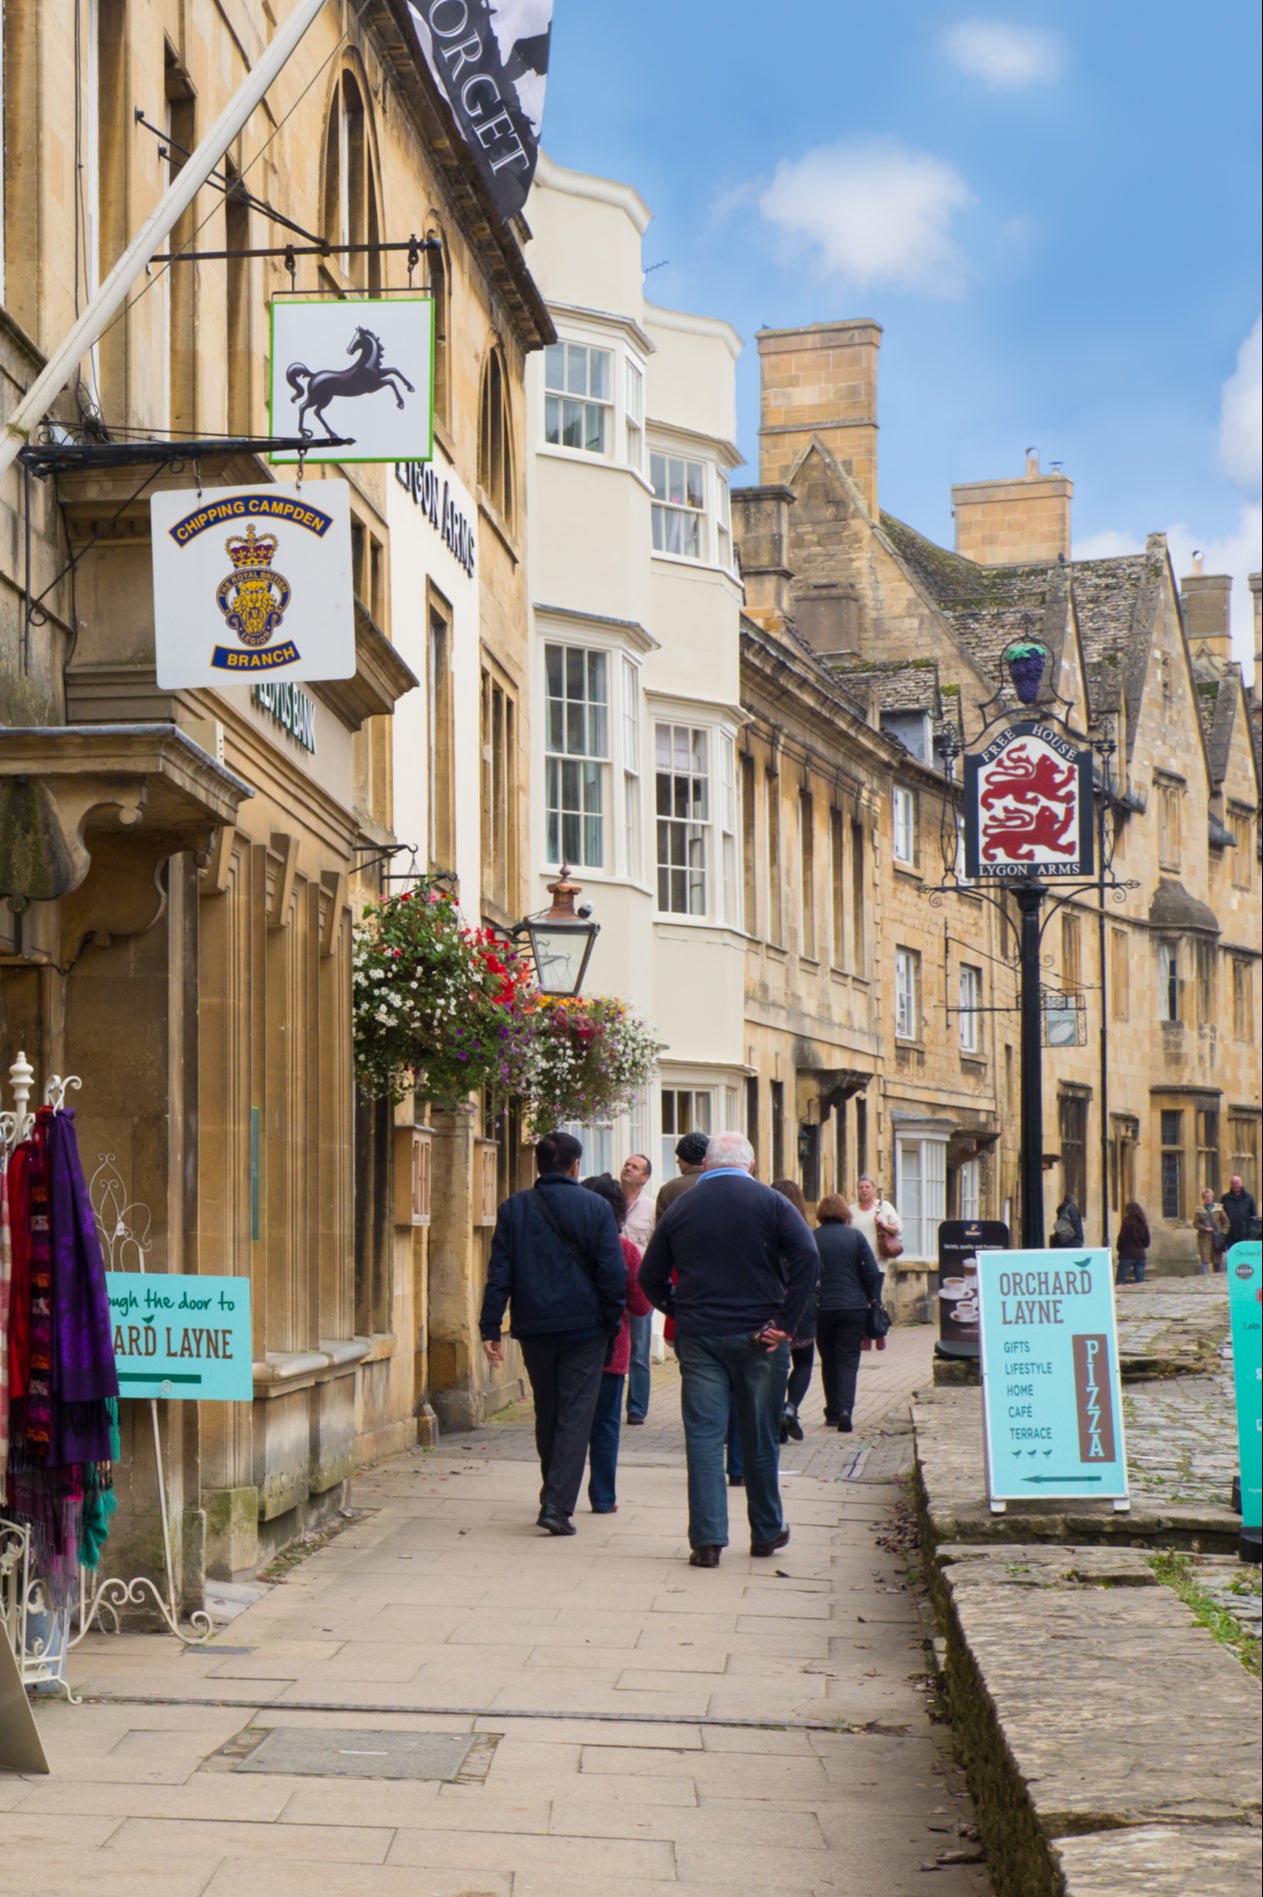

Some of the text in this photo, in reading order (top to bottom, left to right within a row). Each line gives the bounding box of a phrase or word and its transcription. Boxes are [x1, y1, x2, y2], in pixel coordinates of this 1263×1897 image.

[176, 499, 326, 541] CHIPPING CAMPDEN
[441, 480, 475, 578] ARMS
[219, 571, 288, 597] THE ROYAL BRITISH
[241, 631, 270, 645] LEGION
[227, 646, 296, 667] BRANCH
[292, 683, 317, 755] BANK
[981, 724, 1078, 763] FREE HOUSE
[979, 863, 1080, 876] LYGON ARMS
[999, 1269, 1092, 1296] ORCHARD
[144, 1288, 175, 1310] the
[178, 1291, 212, 1311] door
[218, 1291, 235, 1311] to
[1001, 1299, 1064, 1325] LAYNE
[166, 1327, 233, 1359] LAYNE
[1003, 1340, 1030, 1353] GIFTS
[1005, 1362, 1053, 1375] LIFESTYLE
[1006, 1384, 1034, 1397] HOME
[1085, 1339, 1105, 1458] PIZZA
[1008, 1403, 1033, 1418] CAFÉ
[1009, 1427, 1052, 1440] TERRACE
